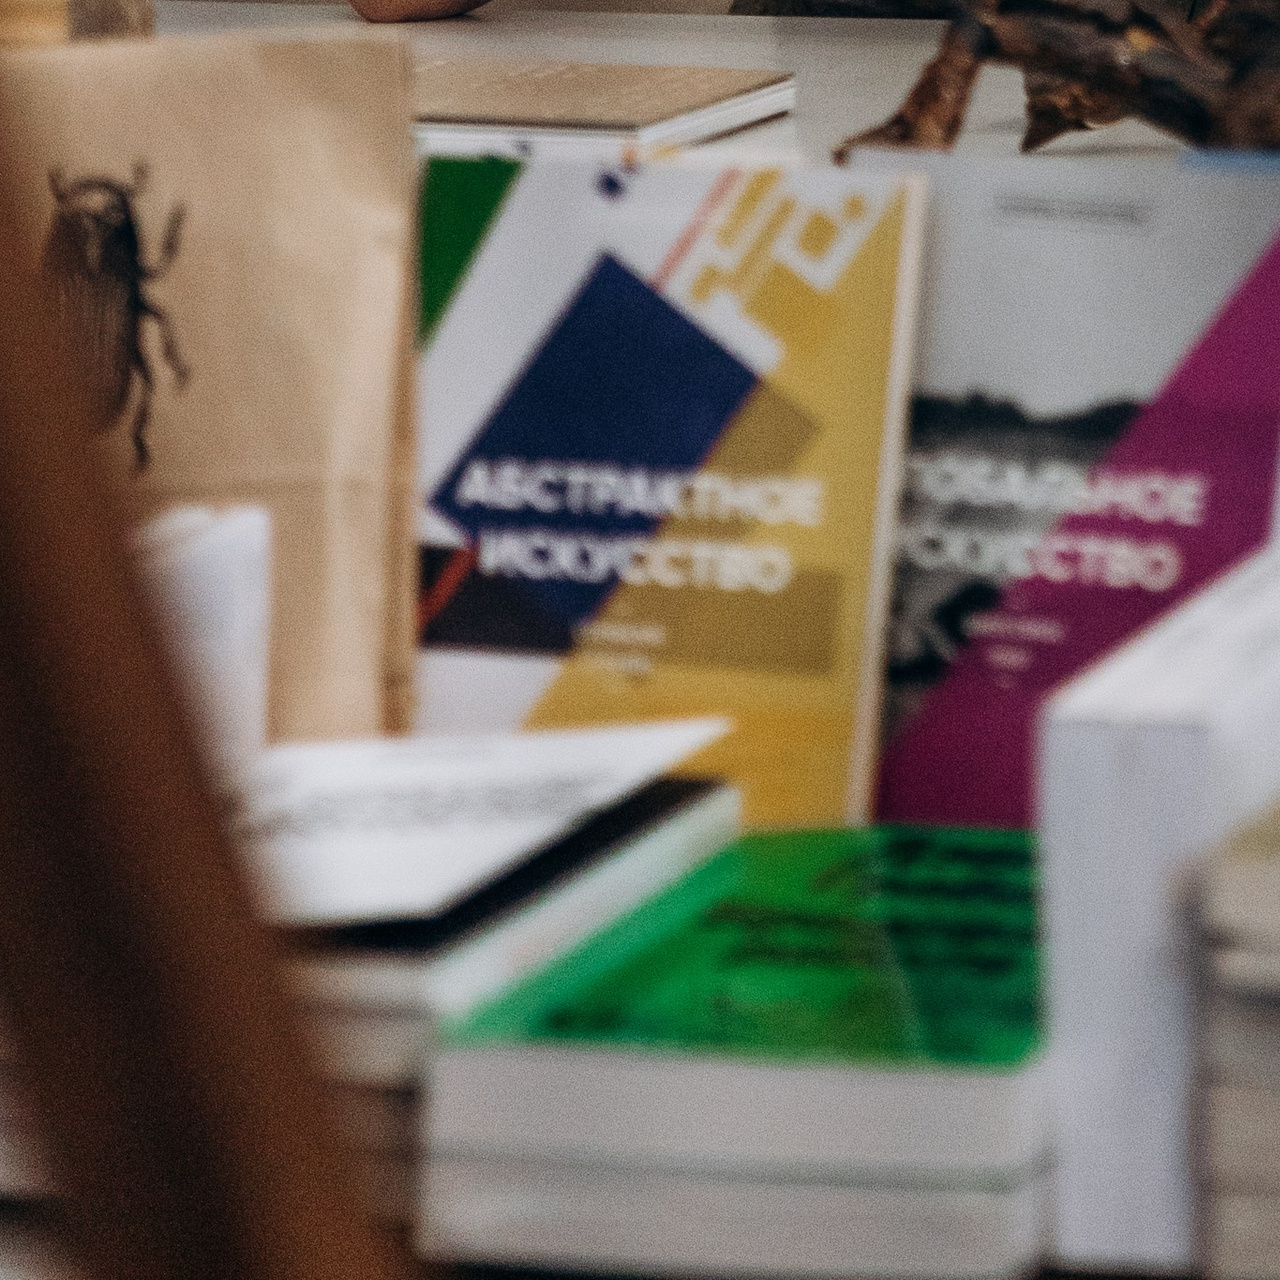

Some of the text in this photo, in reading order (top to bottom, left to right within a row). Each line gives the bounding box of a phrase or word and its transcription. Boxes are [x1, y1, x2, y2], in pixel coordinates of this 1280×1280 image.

[456, 462, 825, 527] АБСТРАКТНОЕ
[478, 529, 795, 595] ИСКУССТВО
[899, 527, 1184, 591] СКУССТВО
